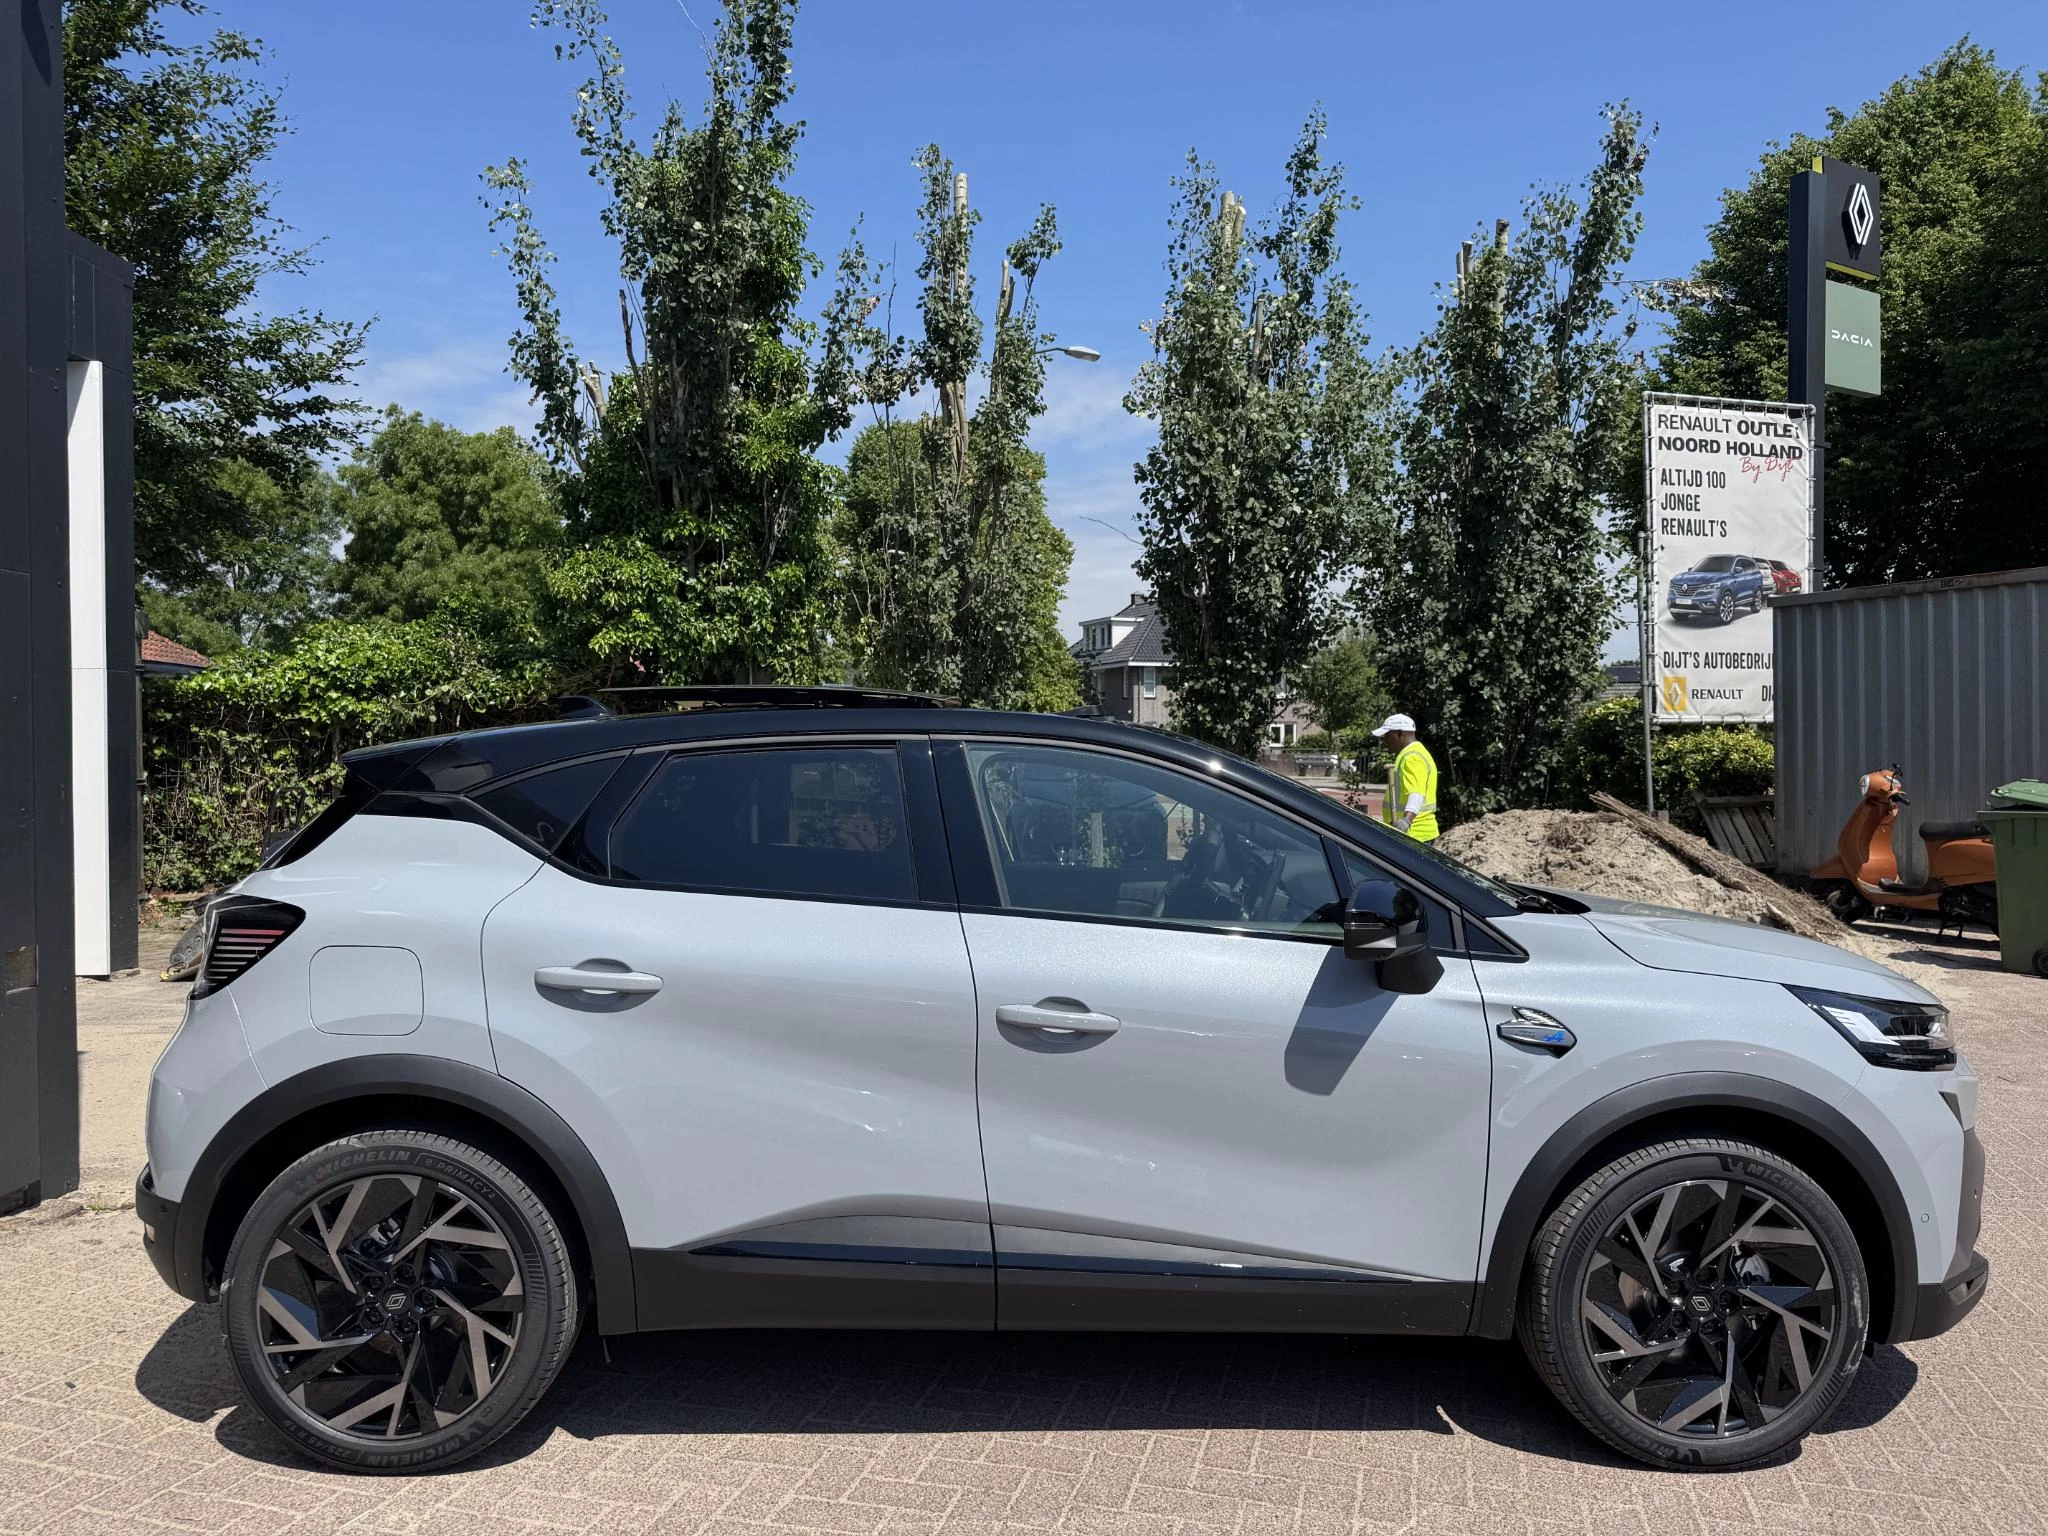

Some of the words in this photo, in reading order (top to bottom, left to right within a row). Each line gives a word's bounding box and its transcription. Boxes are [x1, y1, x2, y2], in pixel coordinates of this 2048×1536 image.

[1831, 329, 1873, 348] DACIA
[1657, 413, 1732, 434] RENAULT
[1658, 436, 1721, 454] NOORD
[1727, 441, 1803, 461] HOLLAND
[1660, 467, 1703, 488] ALTIJD
[1706, 470, 1726, 489] 100
[1740, 456, 1763, 484] By
[1660, 492, 1701, 512] JONGE
[1661, 517, 1728, 538] RENAULT'S
[1663, 651, 1701, 669] DIJT'S
[1691, 688, 1744, 700] RENAULT
[1761, 684, 1773, 702] DI
[316, 1150, 412, 1178] MICHELIN
[367, 1436, 460, 1467] MICHELIN
